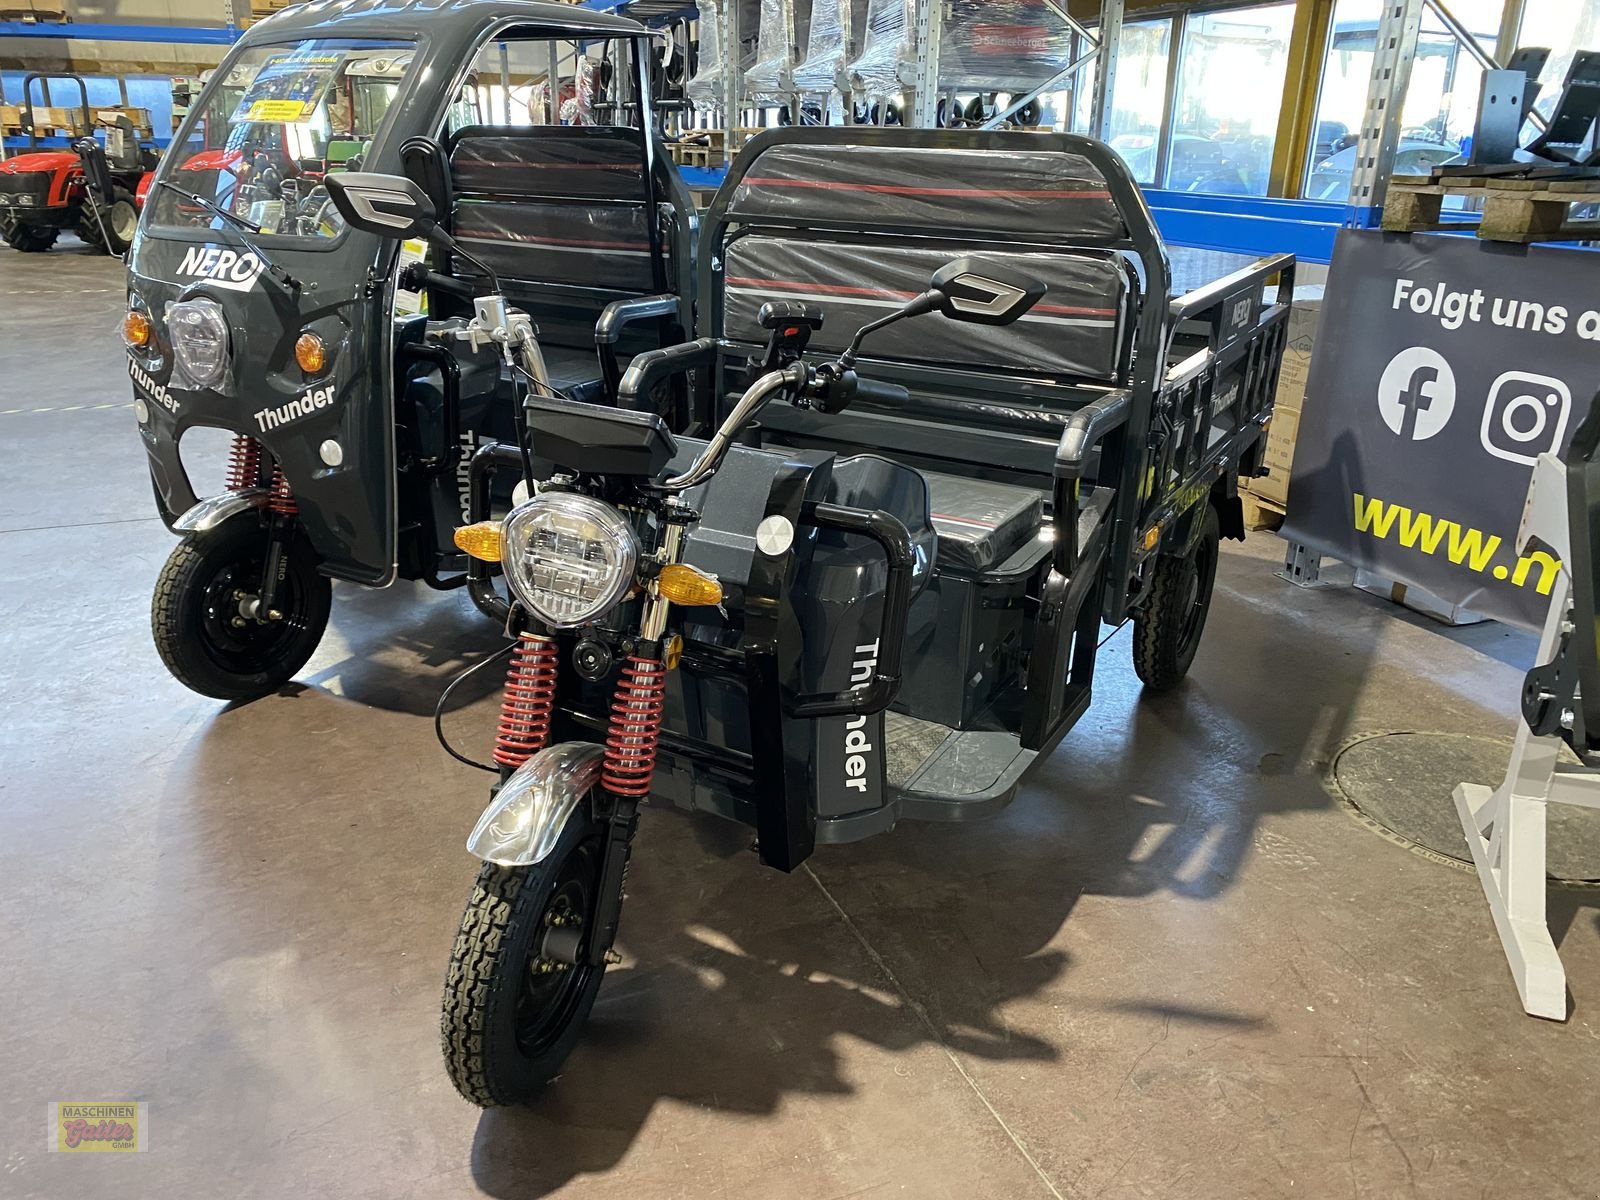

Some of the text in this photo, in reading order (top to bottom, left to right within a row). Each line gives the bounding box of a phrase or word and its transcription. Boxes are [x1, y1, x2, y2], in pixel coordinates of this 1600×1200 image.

[176, 247, 259, 283] NERO
[1392, 278, 1485, 330] Folgt
[1491, 298, 1568, 335] uns
[127, 355, 181, 414] Thunder
[254, 385, 335, 433] Thunder
[278, 555, 288, 581] NERO
